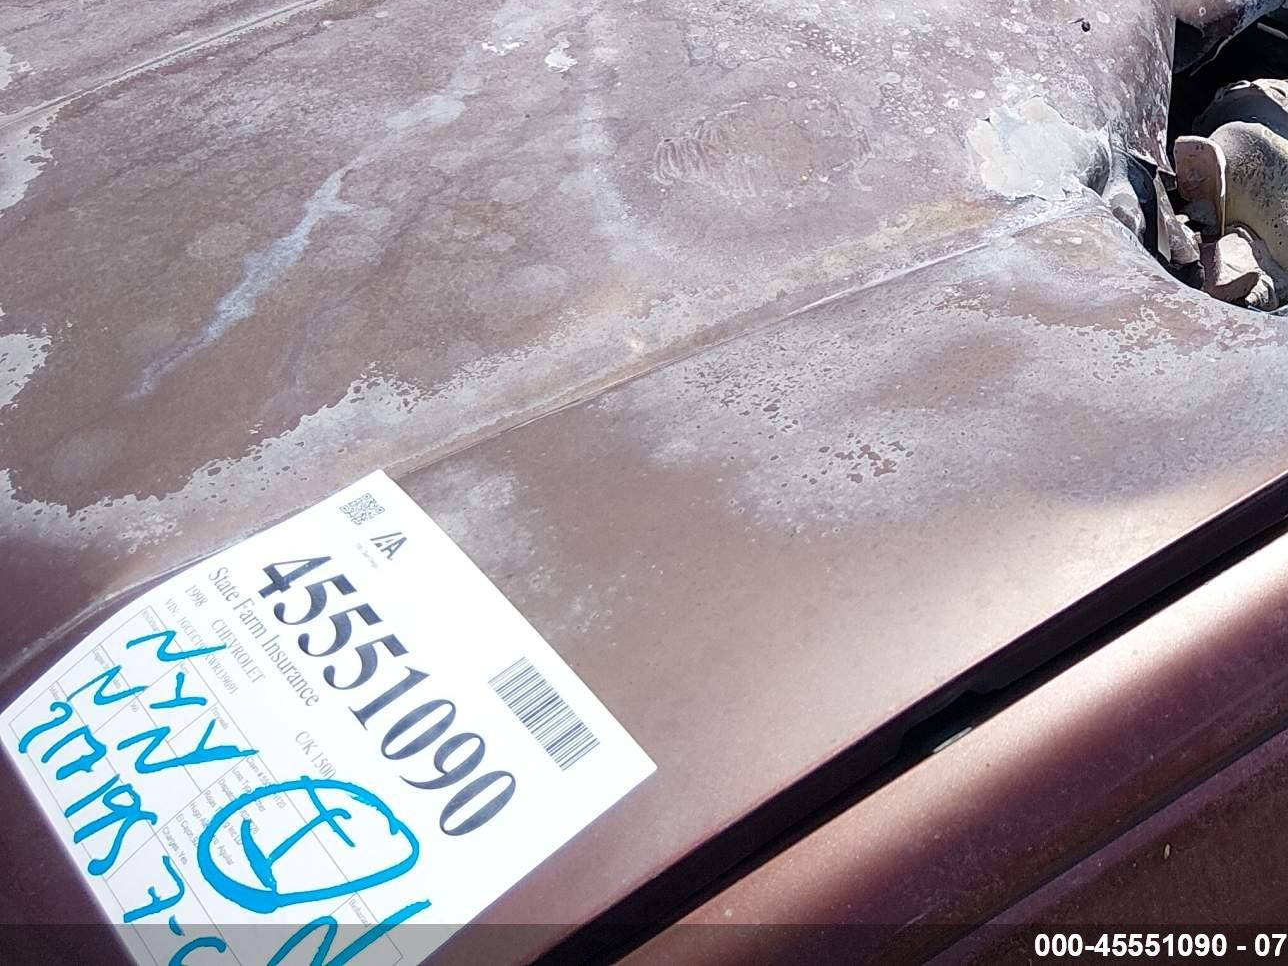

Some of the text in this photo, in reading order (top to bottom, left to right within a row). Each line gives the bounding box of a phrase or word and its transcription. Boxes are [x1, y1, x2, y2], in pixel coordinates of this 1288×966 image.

[185, 585, 336, 780] 1998 CHEVROLET C/K 1500
[208, 567, 319, 707] State Farm Insurance
[258, 556, 516, 836] 45551090
